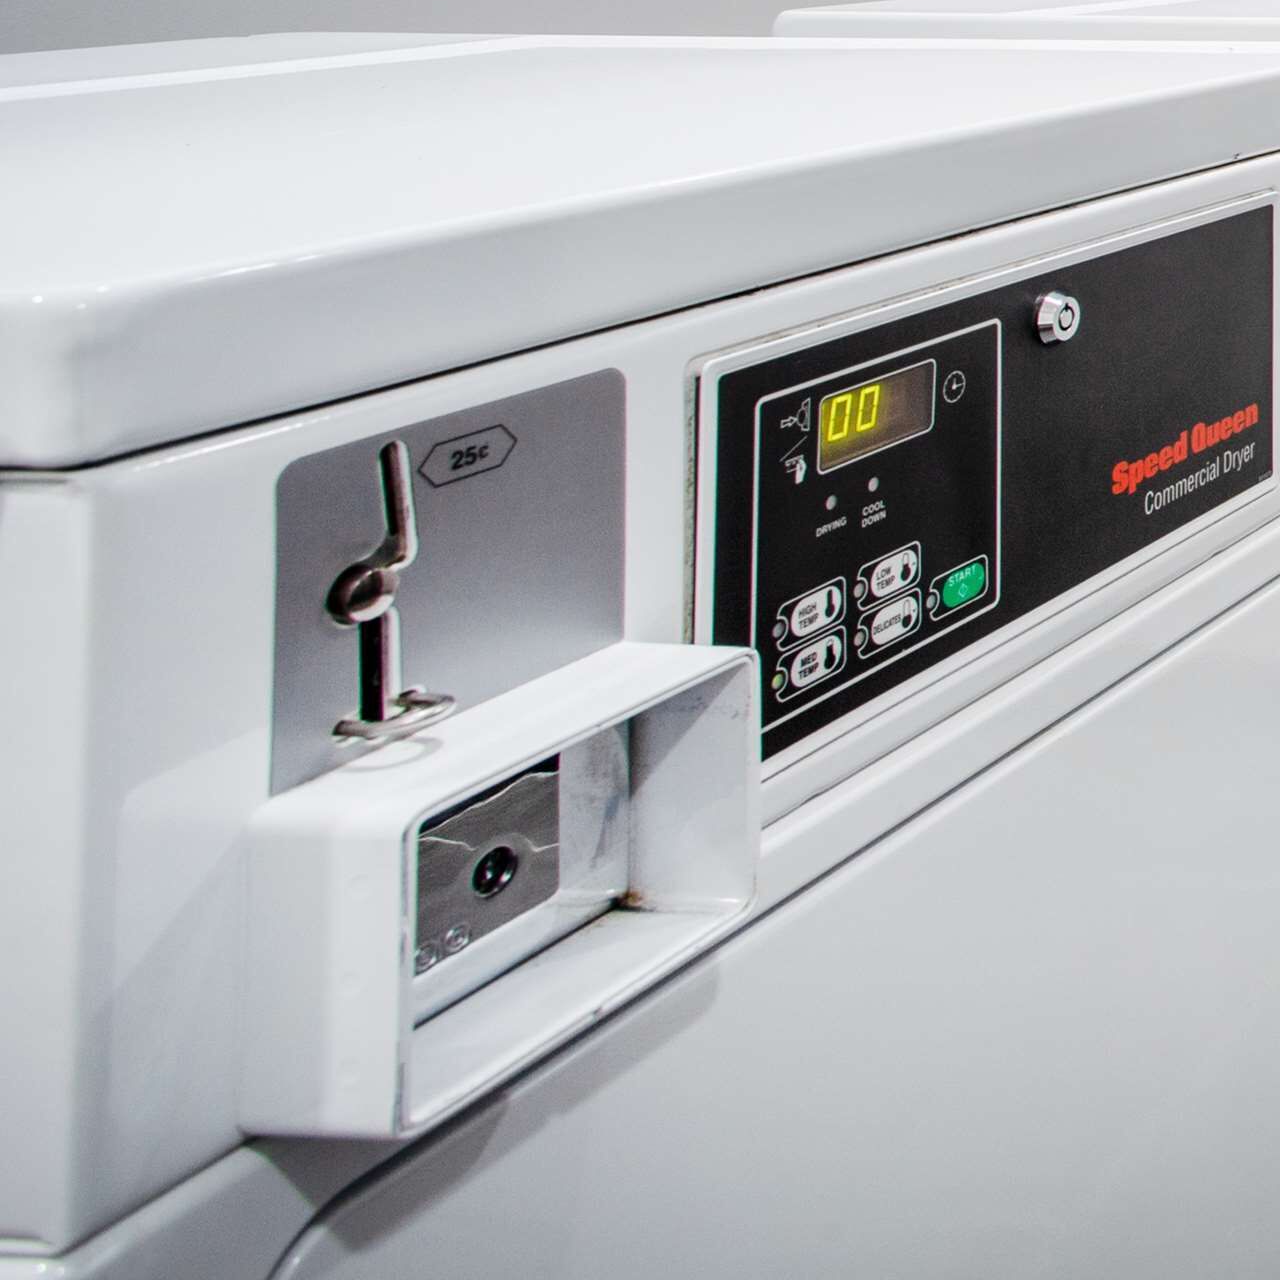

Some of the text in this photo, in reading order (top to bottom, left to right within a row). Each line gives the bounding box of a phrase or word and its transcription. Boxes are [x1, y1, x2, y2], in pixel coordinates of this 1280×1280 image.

[828, 384, 881, 442] 00
[451, 445, 489, 471] 25¢
[1111, 403, 1259, 495] Speed Queen
[1144, 441, 1256, 516] Commercial Dryer
[862, 500, 886, 516] COOL
[862, 509, 887, 528] DOWN
[816, 516, 847, 537] DRYING
[948, 565, 976, 587] START
